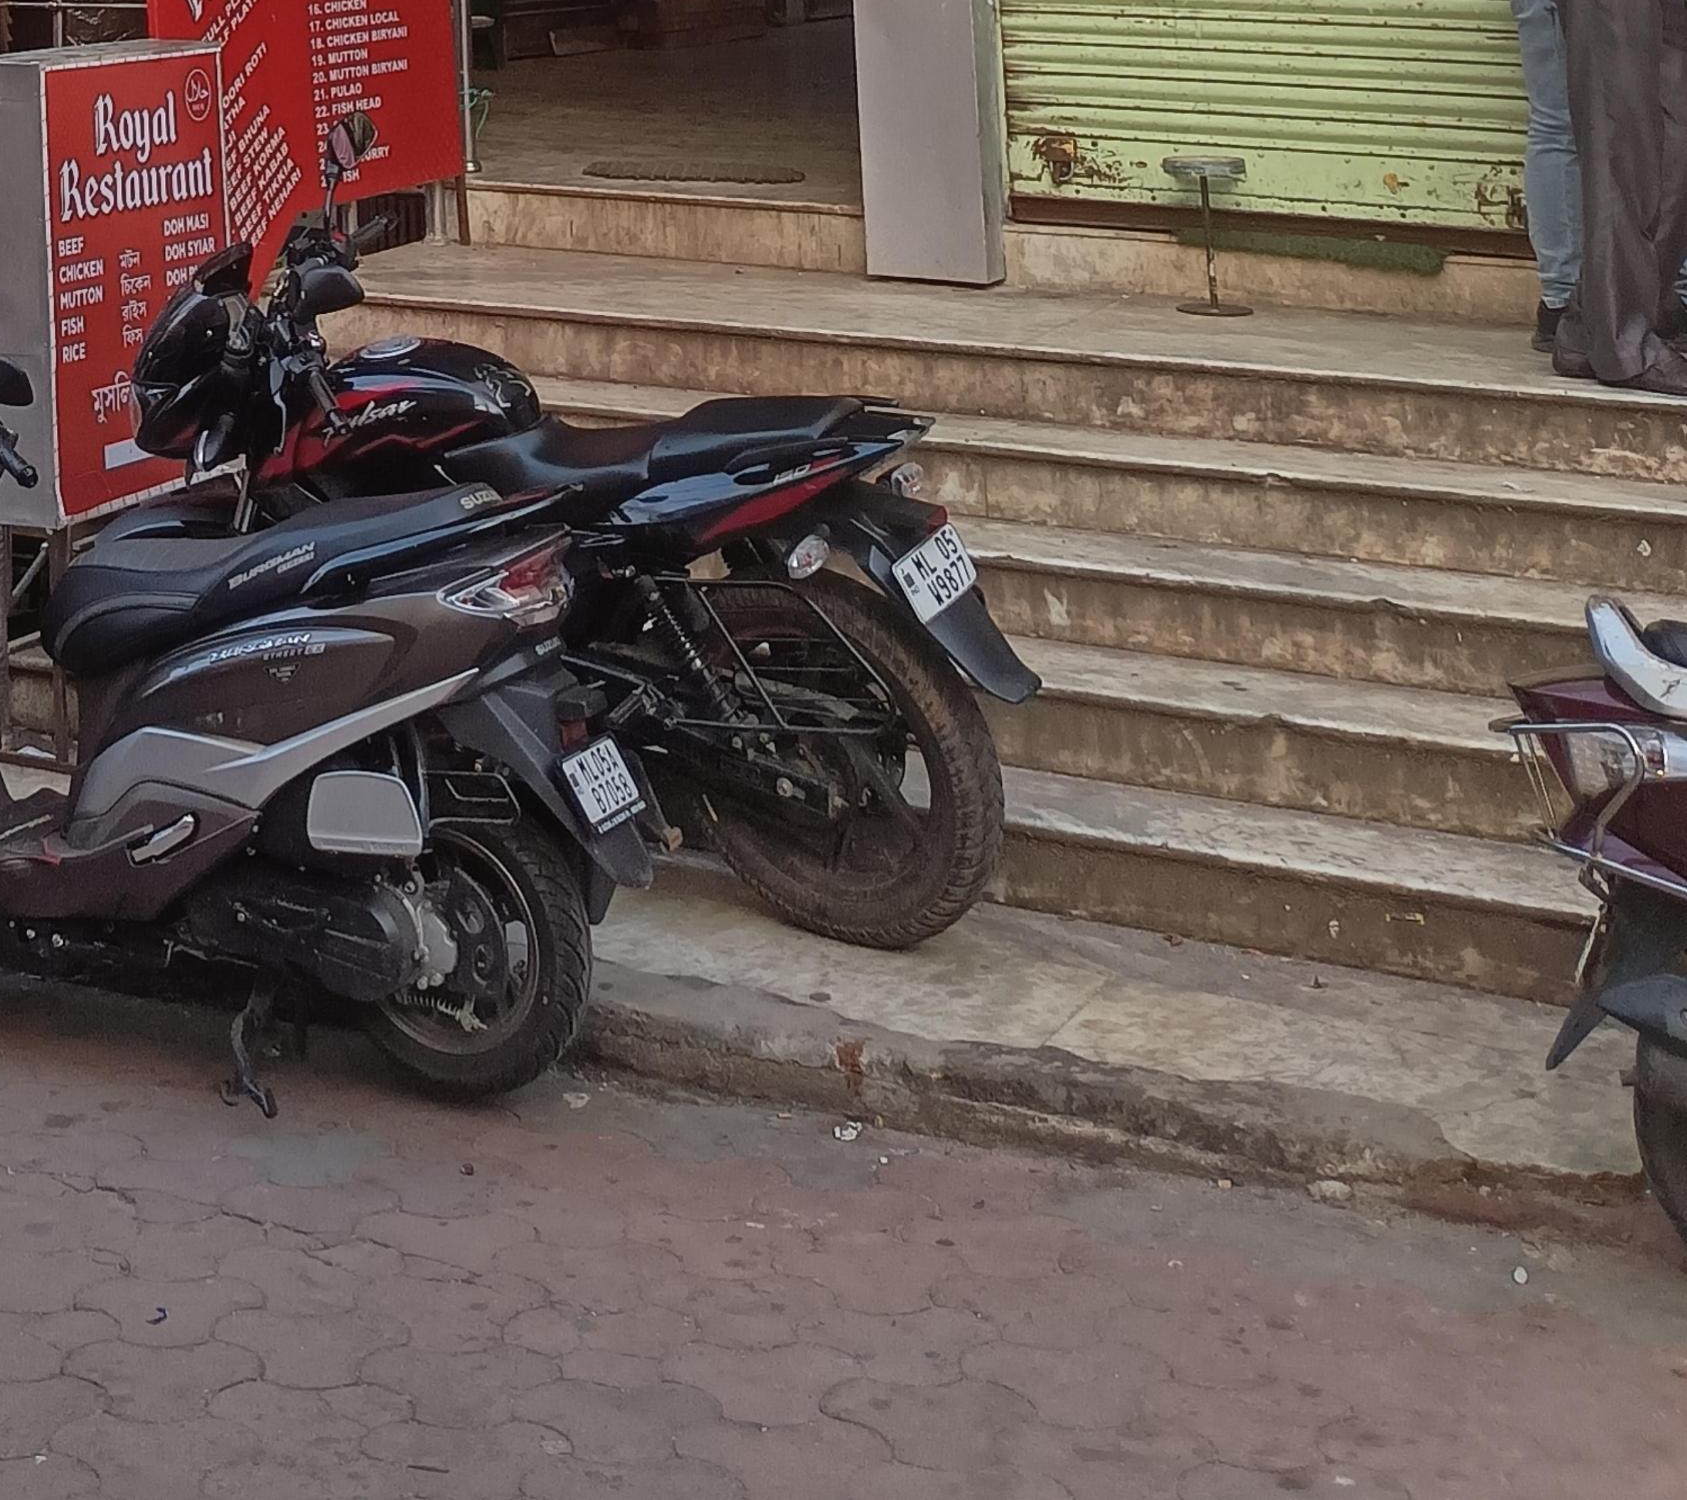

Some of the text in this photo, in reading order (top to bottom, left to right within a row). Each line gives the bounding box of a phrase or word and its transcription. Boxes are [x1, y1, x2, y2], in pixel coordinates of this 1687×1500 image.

[308, 4, 322, 16] 16.
[309, 11, 400, 32] 17. CHICKEN LOCAL
[310, 26, 408, 49] 18. CHICKEN BIRYANI
[244, 42, 267, 76] ROTI
[312, 48, 368, 66] 19. MUTTON
[313, 59, 408, 84] 20. MUTTON BIRYANI
[313, 83, 362, 101] 21. PULAO
[315, 96, 382, 118] 22. FISH HEAD
[94, 90, 177, 163] Royal
[238, 105, 270, 153] BHUNA
[243, 127, 269, 168] STEW
[361, 146, 390, 162] URRY
[229, 171, 252, 212] BEEF
[252, 126, 286, 176] KORMA
[342, 168, 360, 183] ISH
[59, 147, 213, 222] Restaurant
[234, 142, 289, 226] BEEF KABAB
[267, 167, 302, 221] NEHARI
[239, 158, 294, 242] BEEF TIKKIA
[163, 213, 209, 237] DOH MASI
[58, 237, 84, 257] BEEF
[165, 237, 216, 262] DOH SYIAR
[59, 259, 104, 284] CHICKEN
[166, 267, 187, 287] DOH
[60, 285, 103, 310] MUTTON
[120, 274, 151, 297] চিকেন
[121, 300, 147, 322] রাইস
[61, 316, 84, 337] FISH
[122, 325, 143, 348] ফিস
[62, 342, 86, 364] RICE
[91, 370, 131, 424] মুসলি
[911, 530, 958, 580] ML 05
[926, 554, 971, 607] W9877
[576, 743, 620, 786] ML05A
